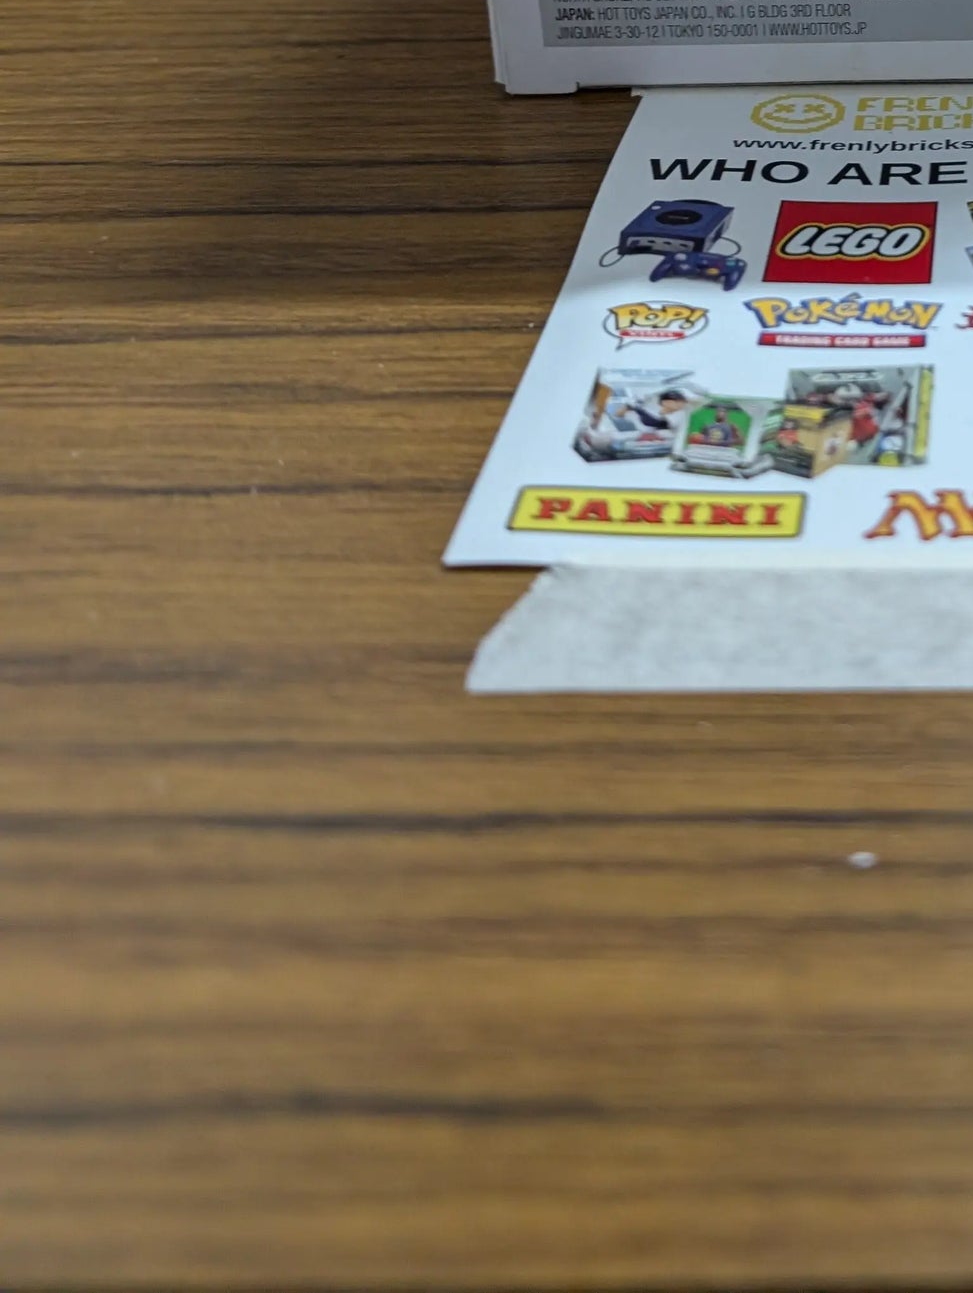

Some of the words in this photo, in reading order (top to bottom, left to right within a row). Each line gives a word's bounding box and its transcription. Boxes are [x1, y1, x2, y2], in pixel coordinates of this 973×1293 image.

[556, 8, 595, 21] JAPAN:
[598, 7, 621, 20] HOT
[624, 6, 650, 20] TOYS
[654, 6, 688, 20] JAPAN
[746, 5, 756, 19] G
[758, 4, 788, 18] BLDG
[790, 4, 812, 18] 3RD
[815, 3, 852, 18] FLOOR
[558, 26, 612, 39] JINGUMAE
[614, 25, 659, 39] 3-30-12
[666, 24, 704, 38] TOKYO
[707, 24, 758, 38] 150-0001
[770, 22, 868, 36] WWW.HOTTOYS.JP
[648, 158, 810, 185] WHO
[826, 161, 969, 187] ARE
[779, 223, 930, 260] LEGO
[607, 302, 709, 330] POP!
[530, 498, 785, 526] PANINI
